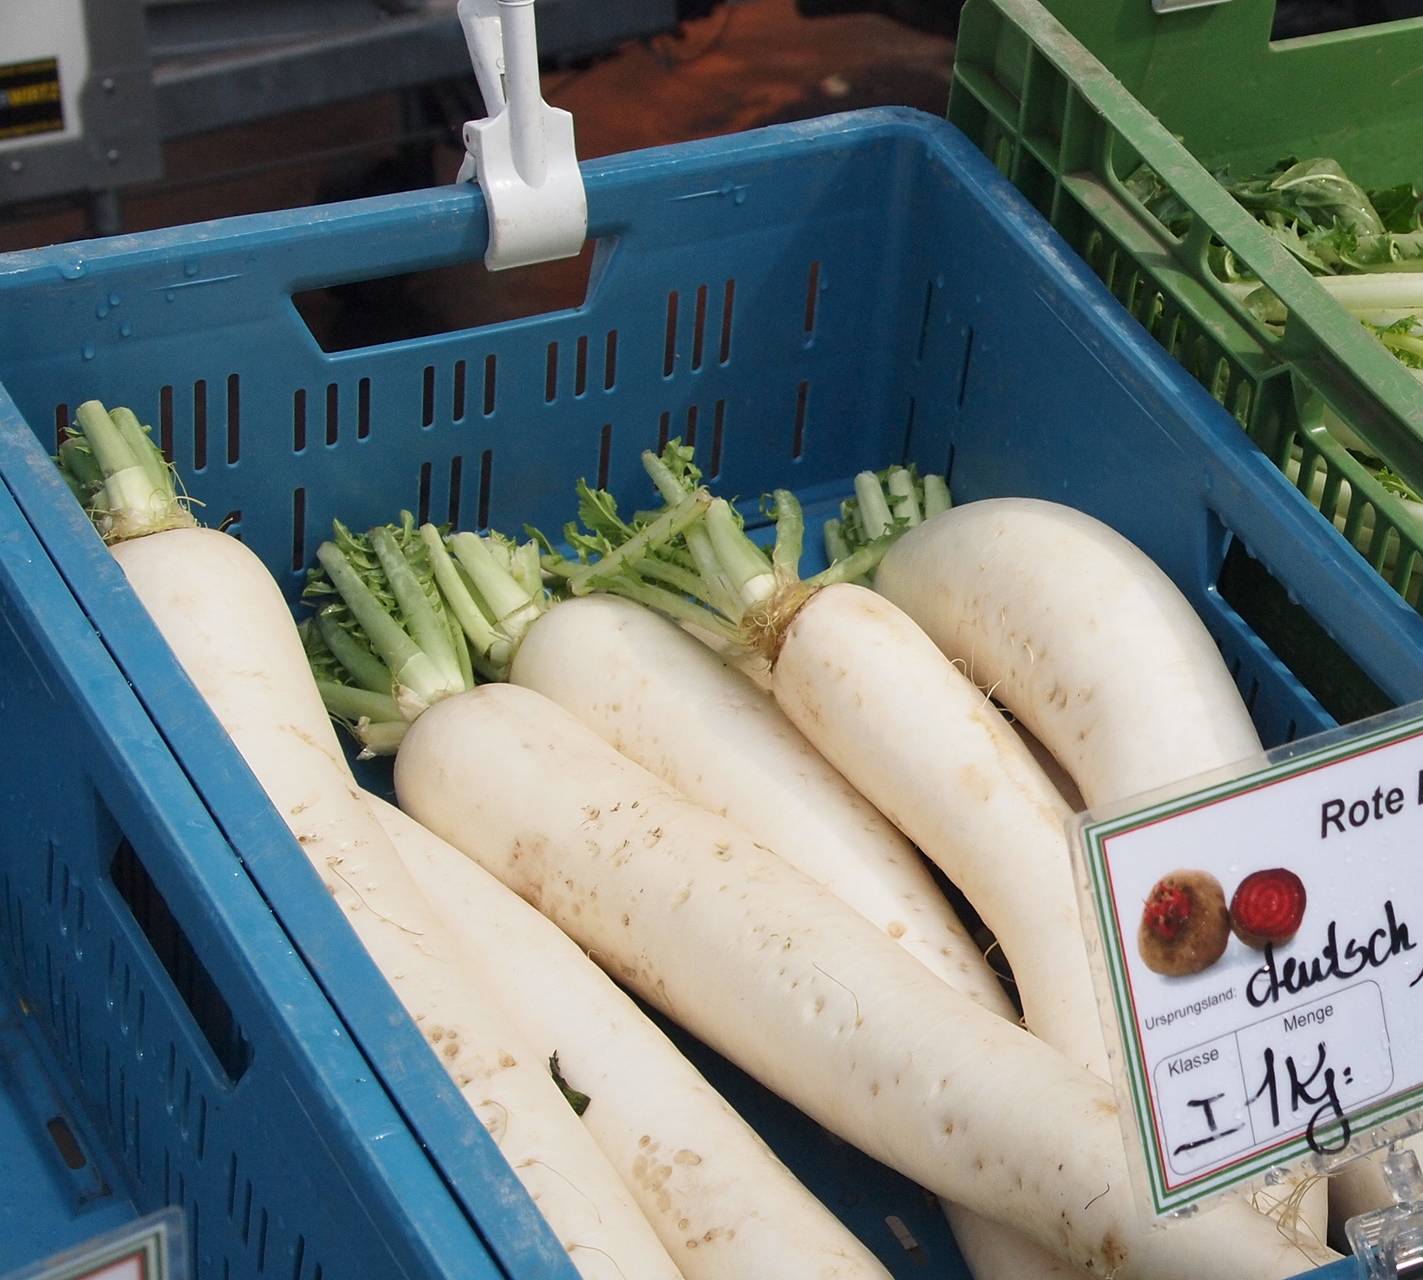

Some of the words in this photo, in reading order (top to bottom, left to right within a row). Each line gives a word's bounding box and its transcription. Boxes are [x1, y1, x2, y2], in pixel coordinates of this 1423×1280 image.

[1320, 785, 1404, 839] Rote
[1144, 987, 1238, 1031] Ursprungsland:
[1246, 900, 1417, 1007] deutsch
[1283, 1003, 1334, 1033] Menge
[1168, 1048, 1219, 1077] Klasse
